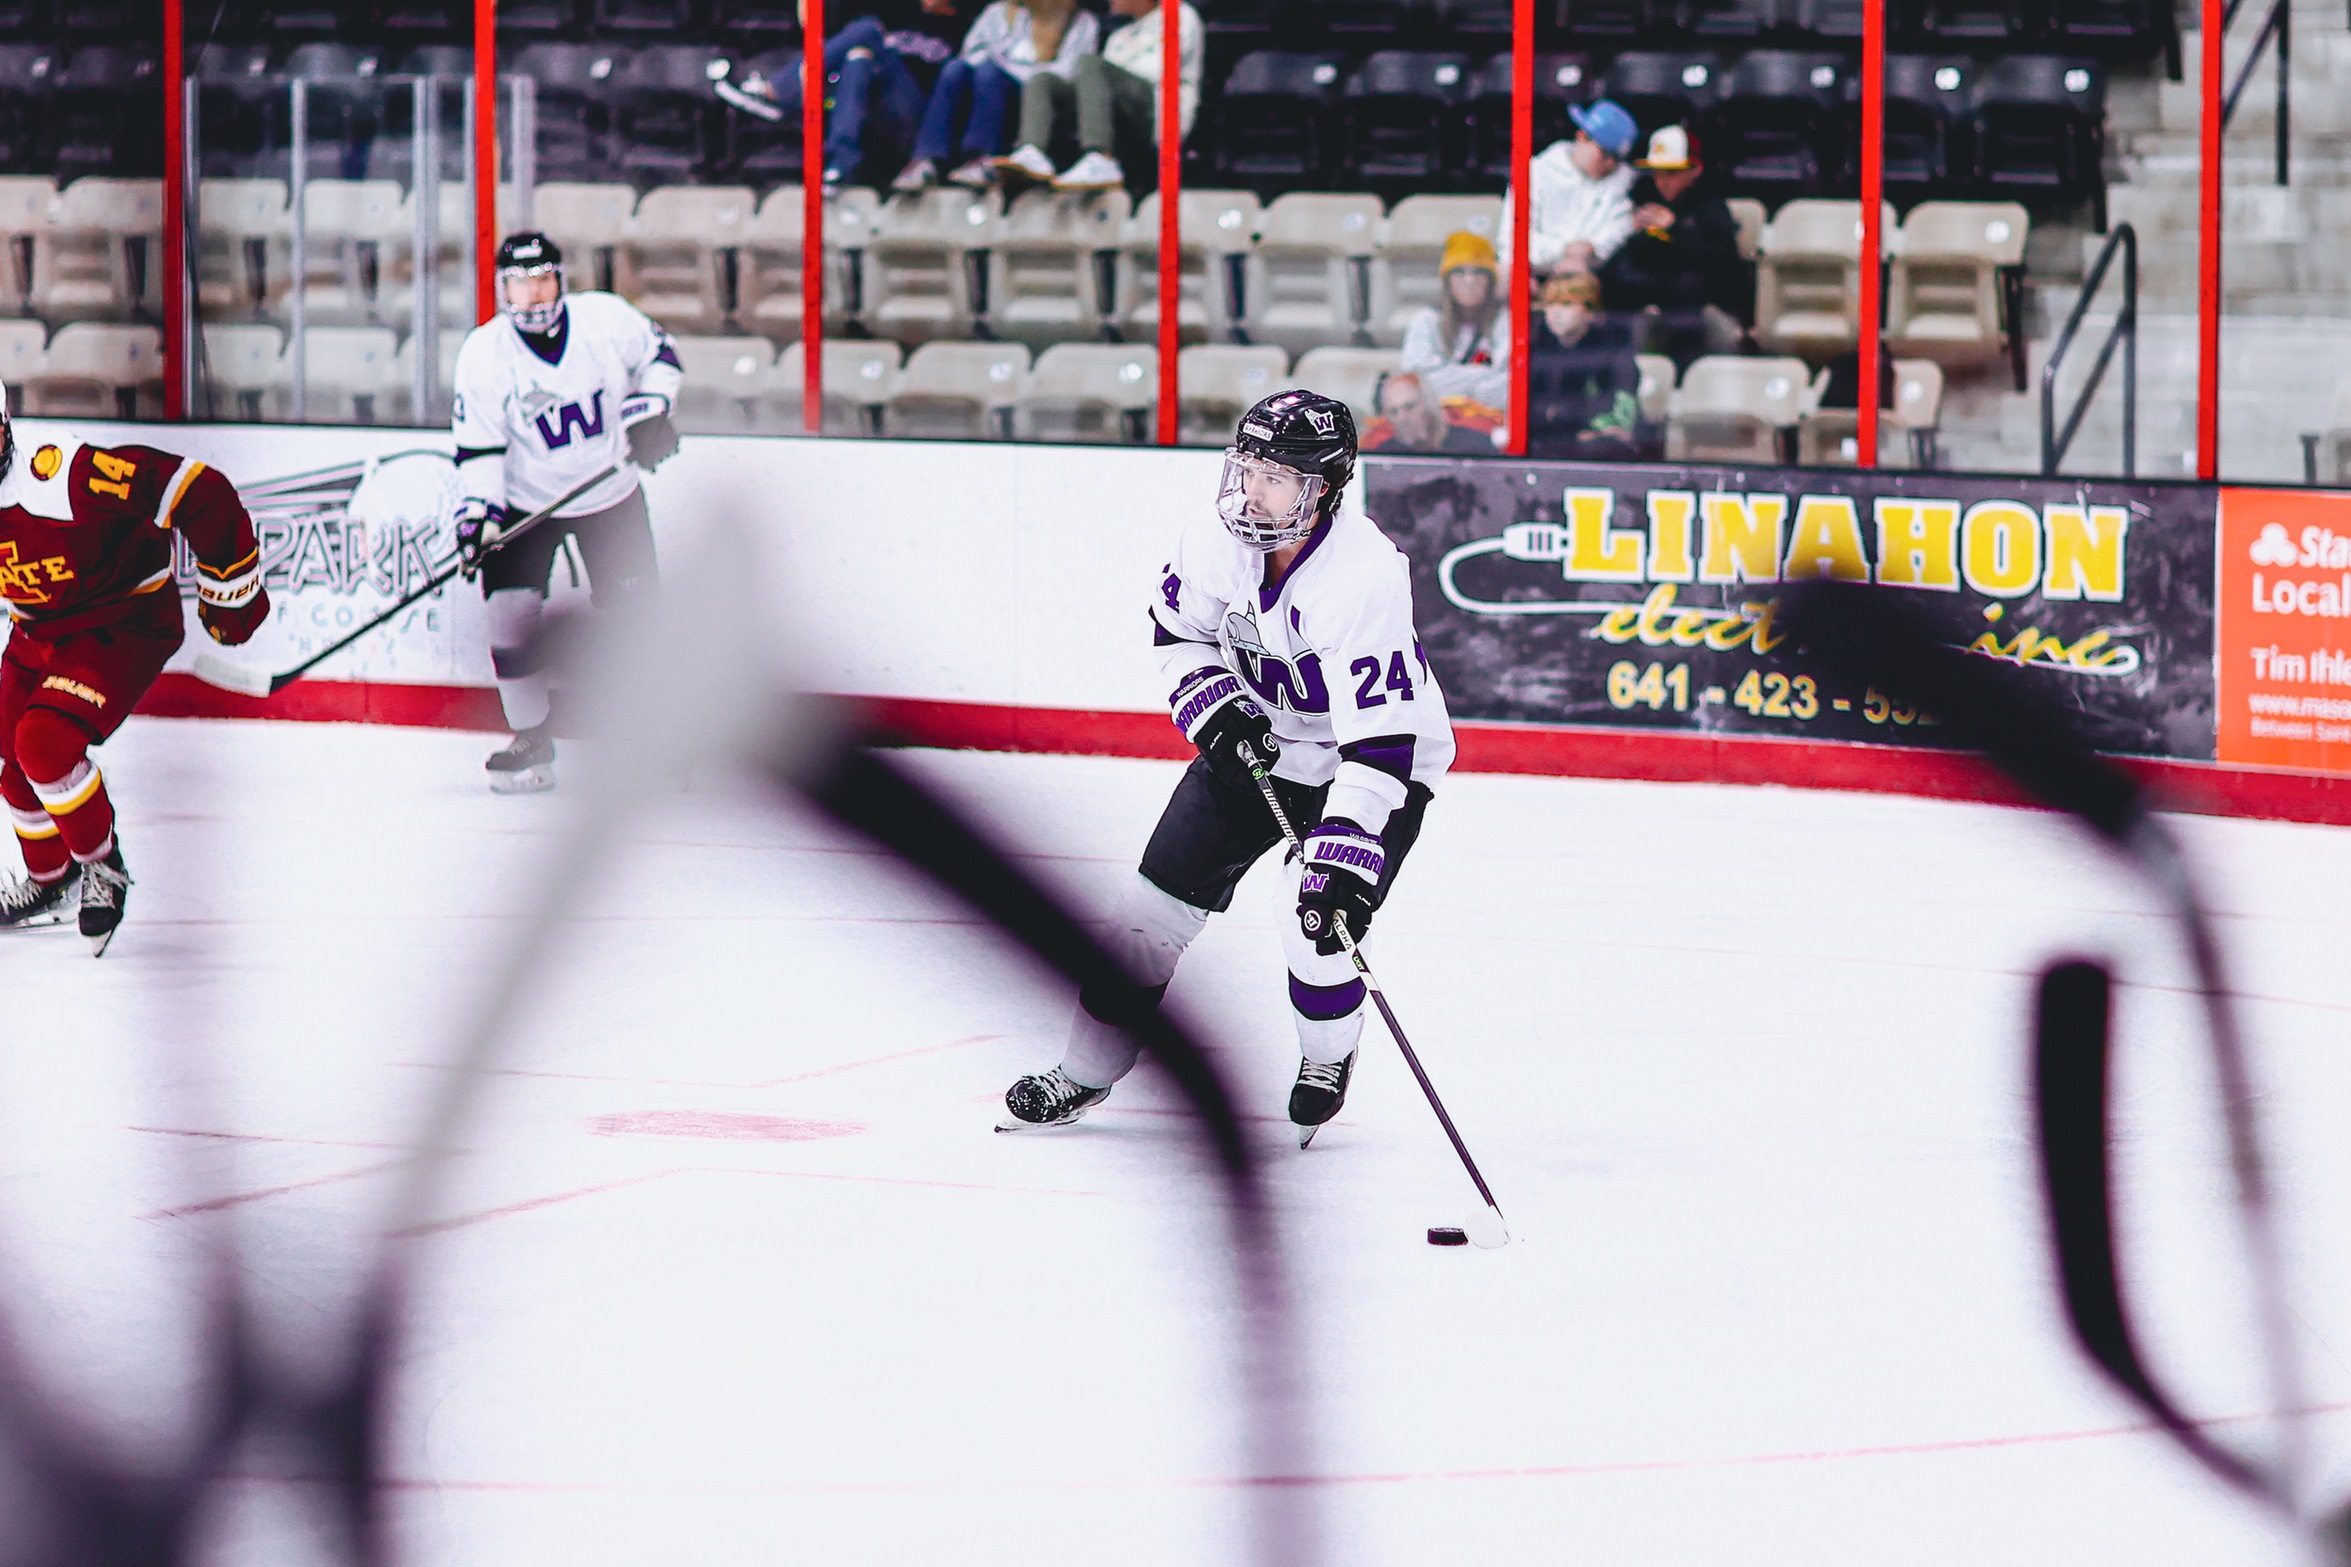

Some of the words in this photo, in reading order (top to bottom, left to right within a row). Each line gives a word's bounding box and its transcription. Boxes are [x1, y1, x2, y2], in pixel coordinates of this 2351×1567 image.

[535, 388, 604, 451] W
[88, 450, 137, 501] 14
[1562, 487, 2130, 602] LINAHON
[2299, 526, 2351, 570] Sta
[0, 555, 76, 596] ATE
[2252, 572, 2351, 617] Local
[1588, 583, 1788, 655] elect
[1349, 650, 1415, 709] 24
[1606, 660, 1691, 712] 641
[1733, 668, 1820, 720] 423
[2250, 644, 2306, 682] Tim
[1262, 788, 1299, 845] WARRIOR
[1333, 918, 1353, 951] ALPHA
